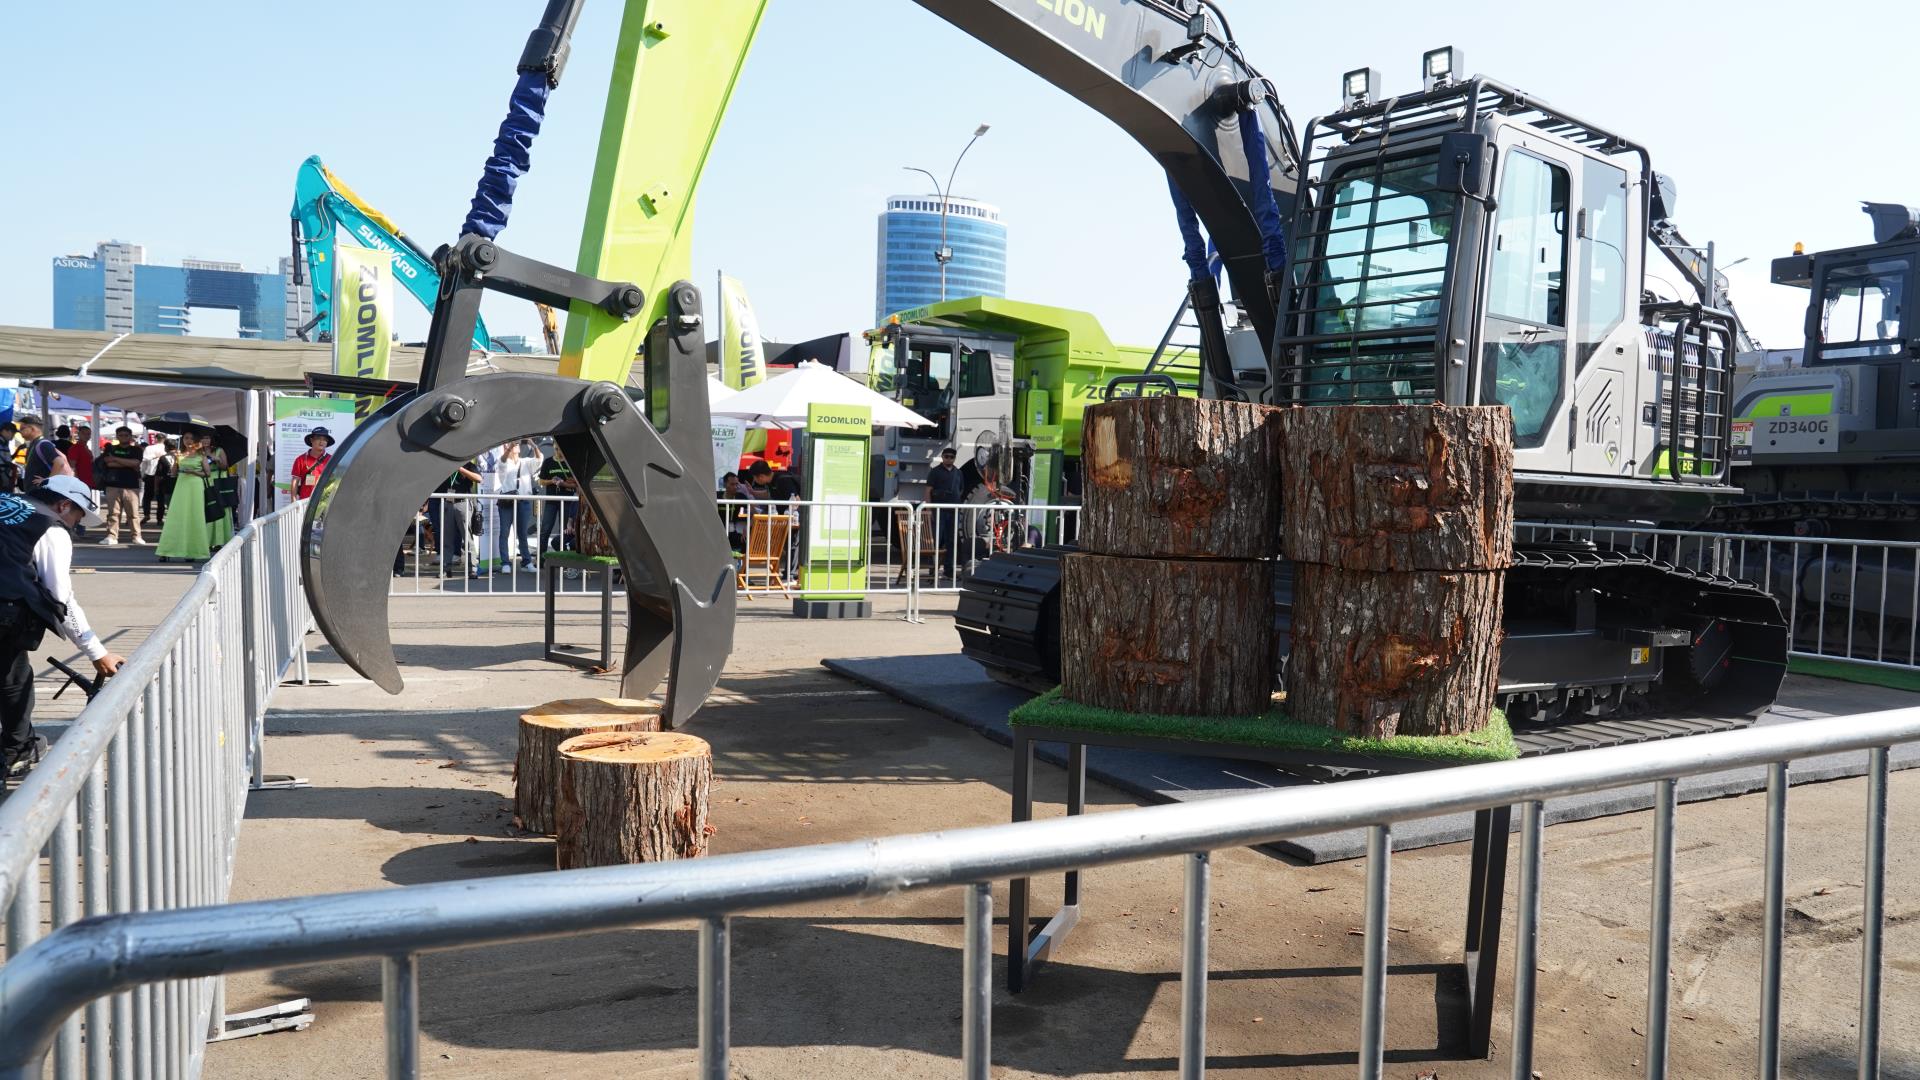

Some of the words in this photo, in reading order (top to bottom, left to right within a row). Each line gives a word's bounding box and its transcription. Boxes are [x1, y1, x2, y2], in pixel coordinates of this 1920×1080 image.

[54, 259, 88, 268] ASTON
[817, 415, 866, 425] ZOOMLION
[1769, 420, 1828, 434] ZD340G
